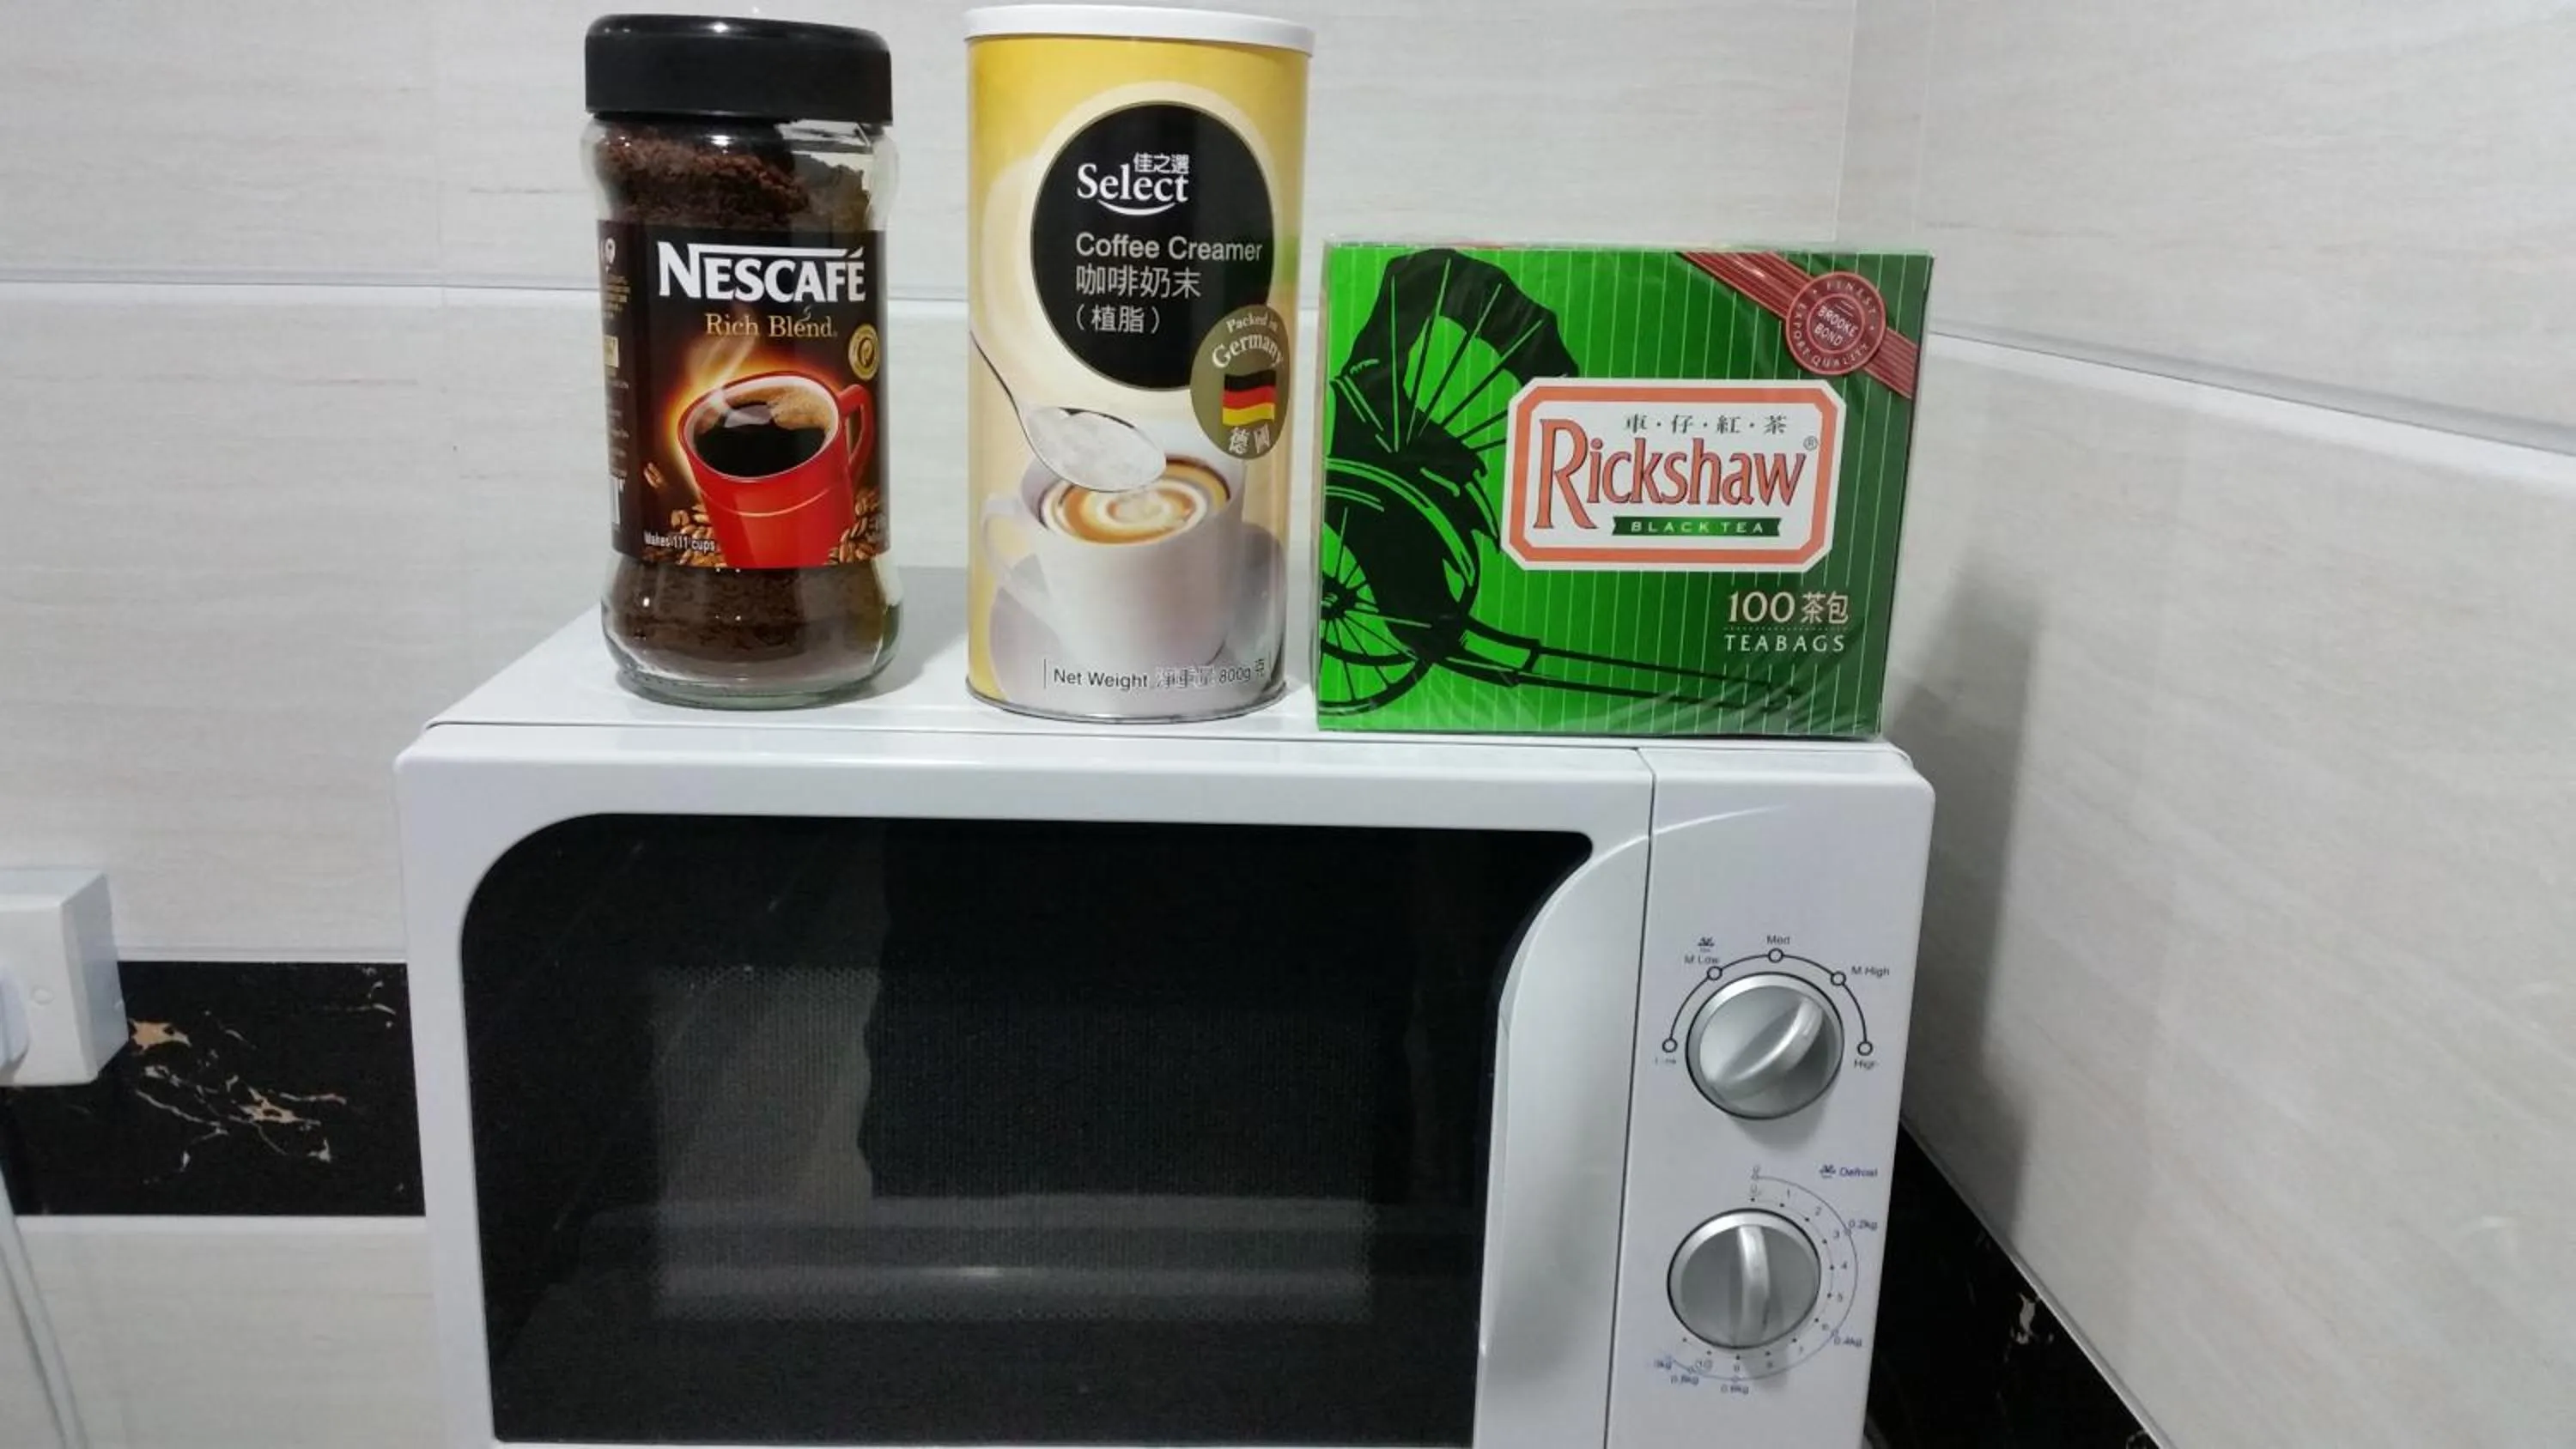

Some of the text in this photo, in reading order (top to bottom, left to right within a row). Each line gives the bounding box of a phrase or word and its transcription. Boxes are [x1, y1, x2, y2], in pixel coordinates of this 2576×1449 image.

[1077, 163, 1188, 203] Select
[1076, 233, 1263, 261] Coffee Creamer
[657, 241, 866, 302] NESCAFÉ
[1076, 263, 1201, 299] 咖啡奶末
[705, 313, 760, 336] Rich
[1226, 312, 1268, 333] Packed
[1818, 305, 1859, 337] BROOKE
[1814, 323, 1844, 346] BOND
[1212, 334, 1284, 368] Germany
[1812, 343, 1868, 367] QUALITY
[1533, 418, 1807, 529] Rickshaw
[1631, 520, 1765, 534] BLACK TEA
[691, 539, 715, 554] cups
[1728, 591, 1849, 624] 100 茶包
[1724, 634, 1845, 652] TEABAGS
[1054, 668, 1082, 685] Net
[1089, 672, 1147, 691] Weight
[1766, 934, 1790, 945] Med
[1864, 967, 1890, 979] High
